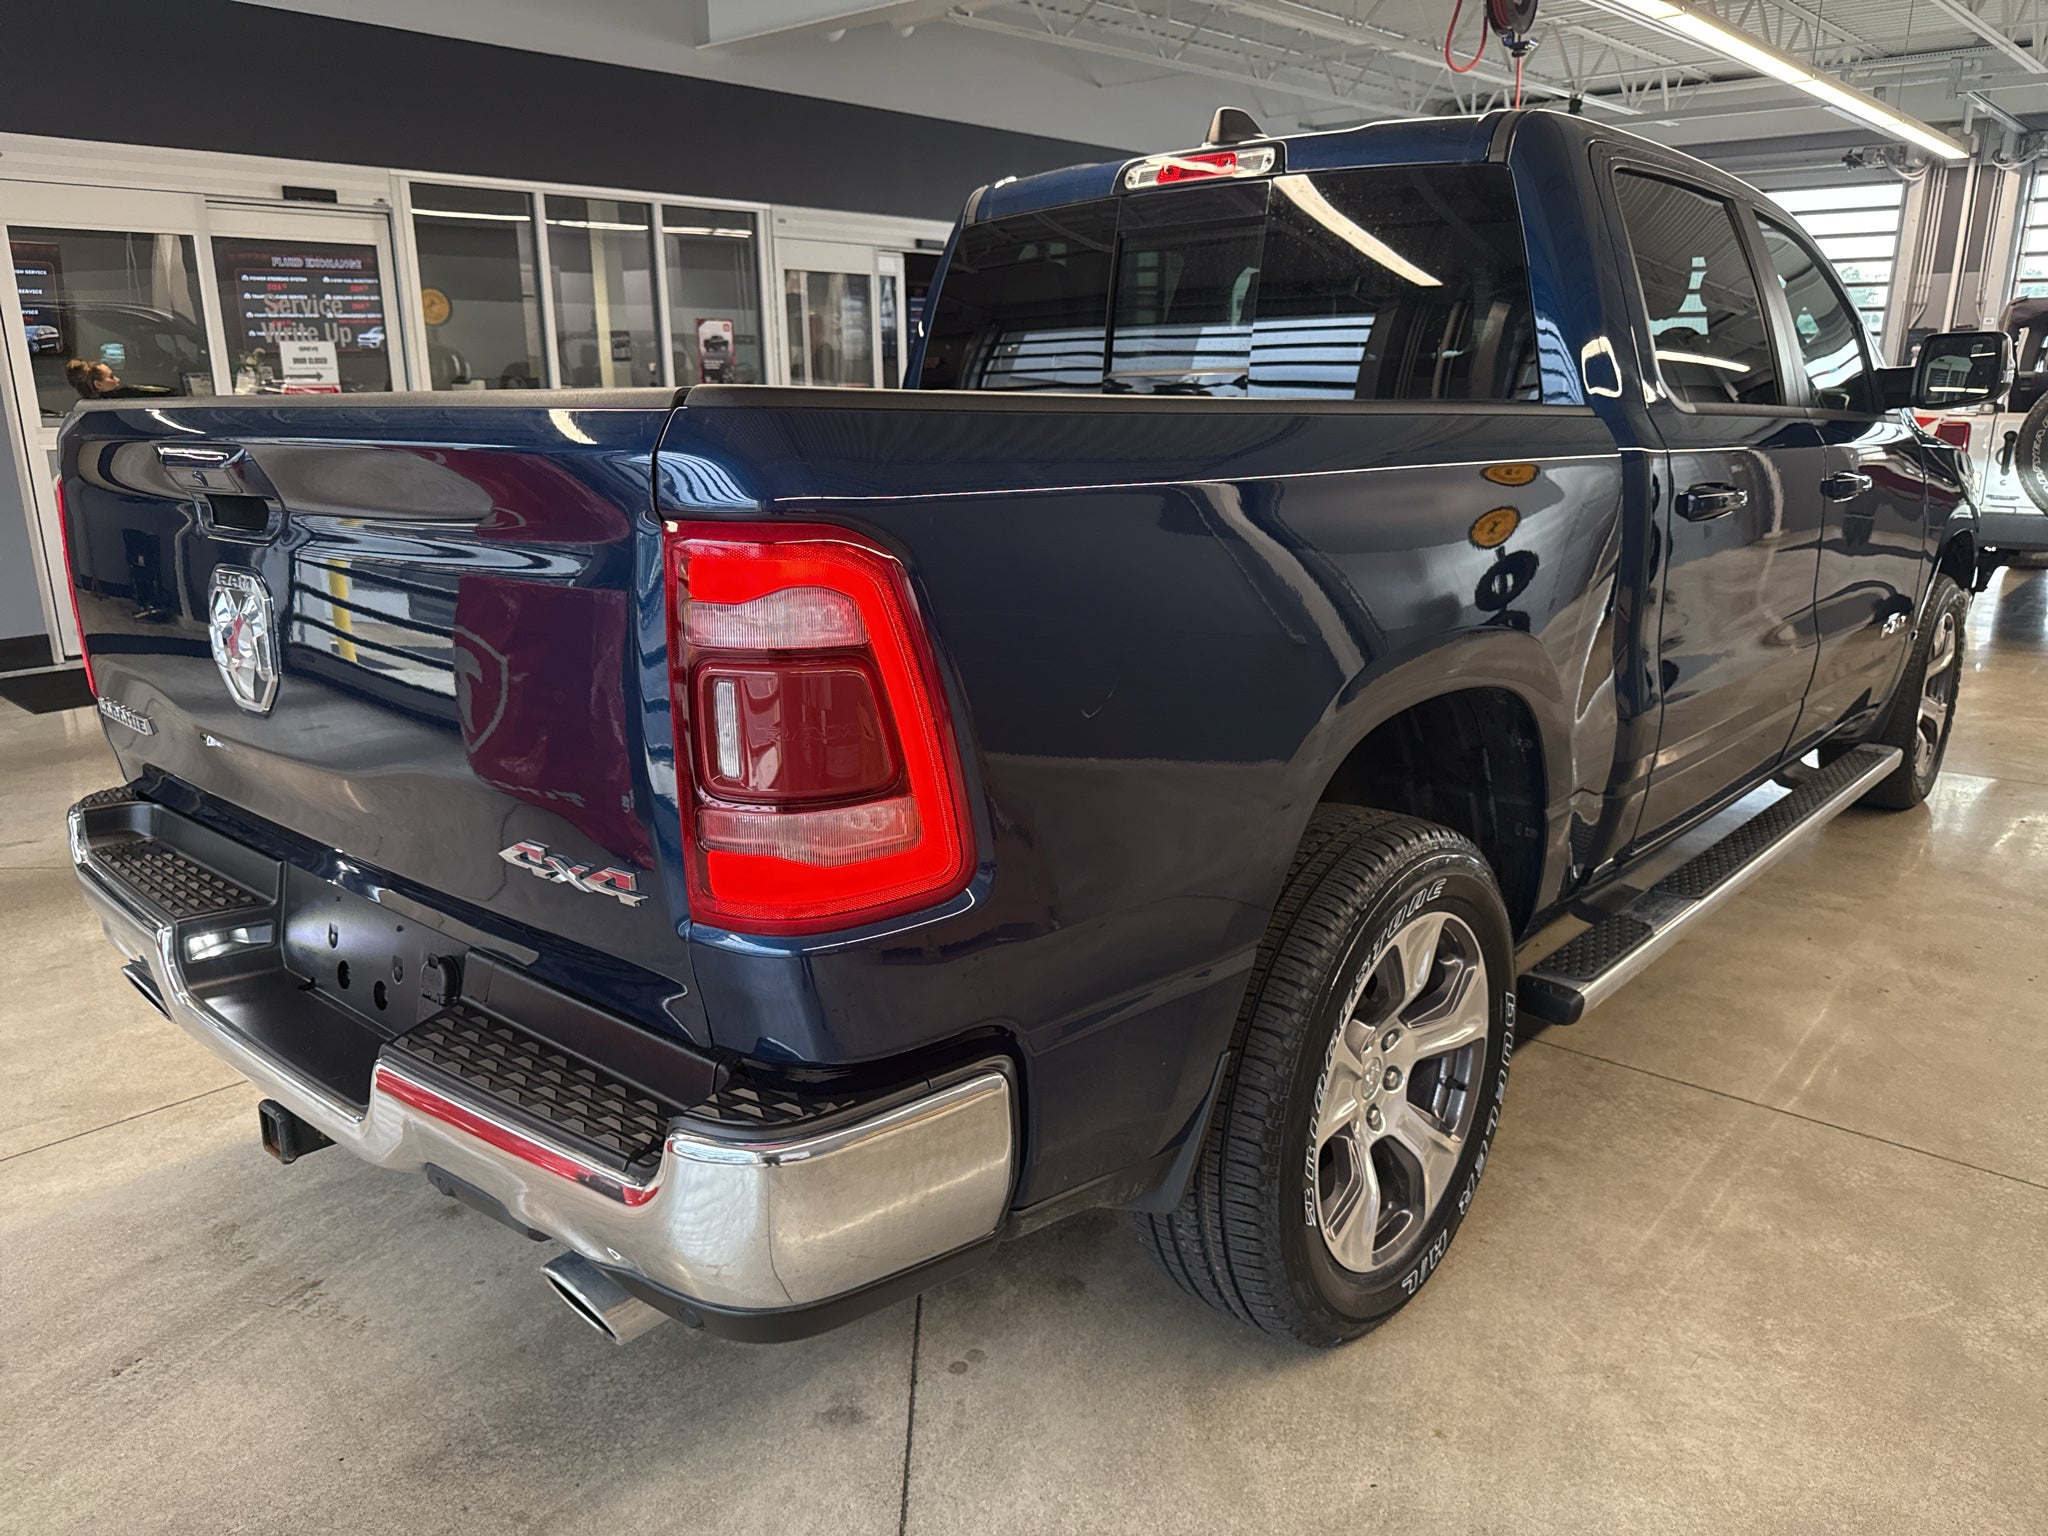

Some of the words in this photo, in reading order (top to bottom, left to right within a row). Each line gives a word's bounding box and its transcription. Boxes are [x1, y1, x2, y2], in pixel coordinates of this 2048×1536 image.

[262, 293, 344, 317] Service
[260, 321, 320, 343] Write
[324, 322, 352, 347] Up
[215, 571, 252, 592] RAM
[1457, 991, 1517, 1215] DUELER
